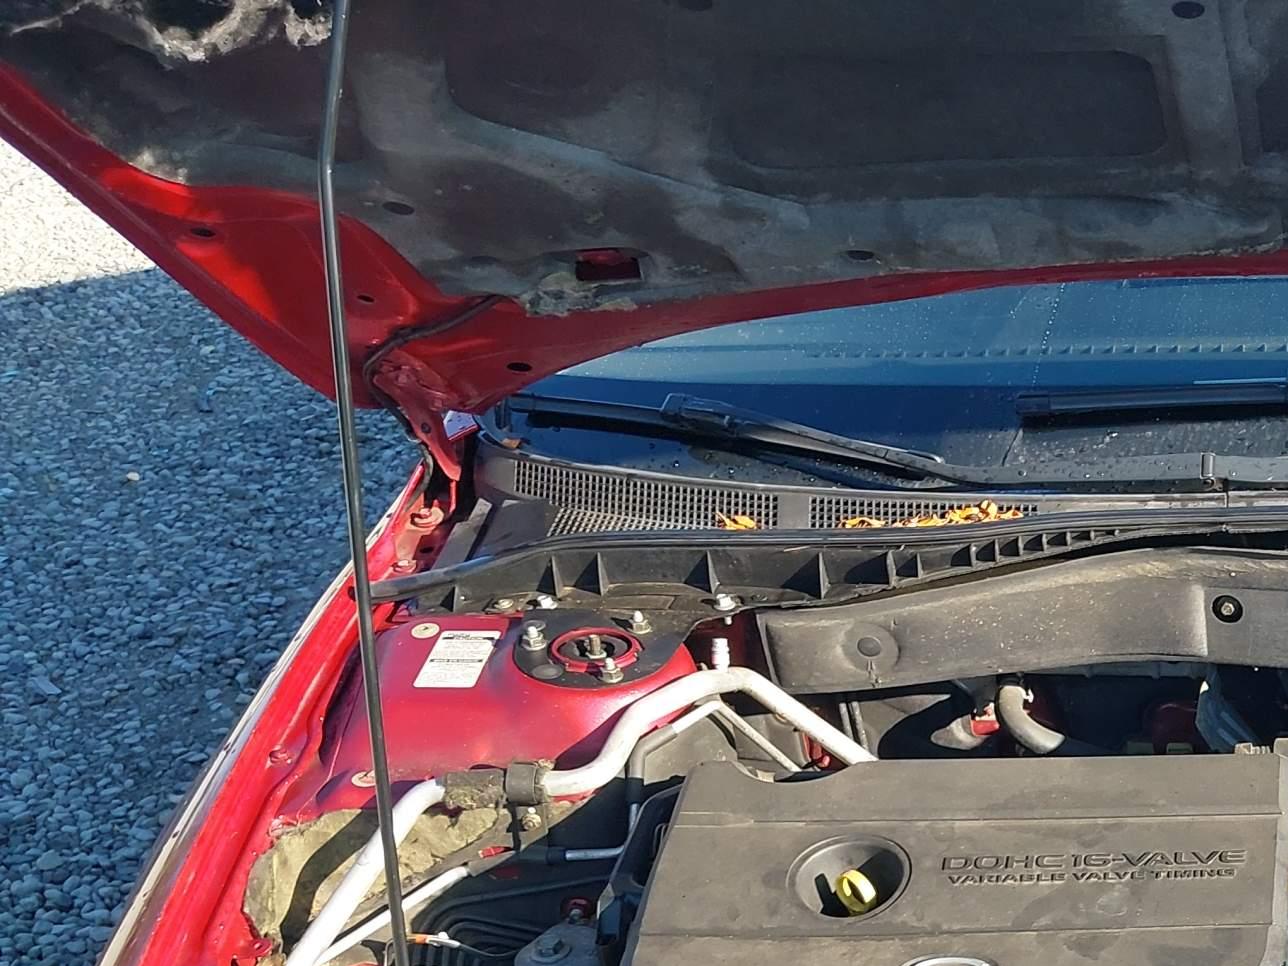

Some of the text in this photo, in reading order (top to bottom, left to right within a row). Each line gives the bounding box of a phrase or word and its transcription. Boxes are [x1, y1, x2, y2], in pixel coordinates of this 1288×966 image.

[942, 848, 1248, 871] DOHC 16-VALVE
[948, 867, 1237, 885] VARIABLE VALVE TIMING
